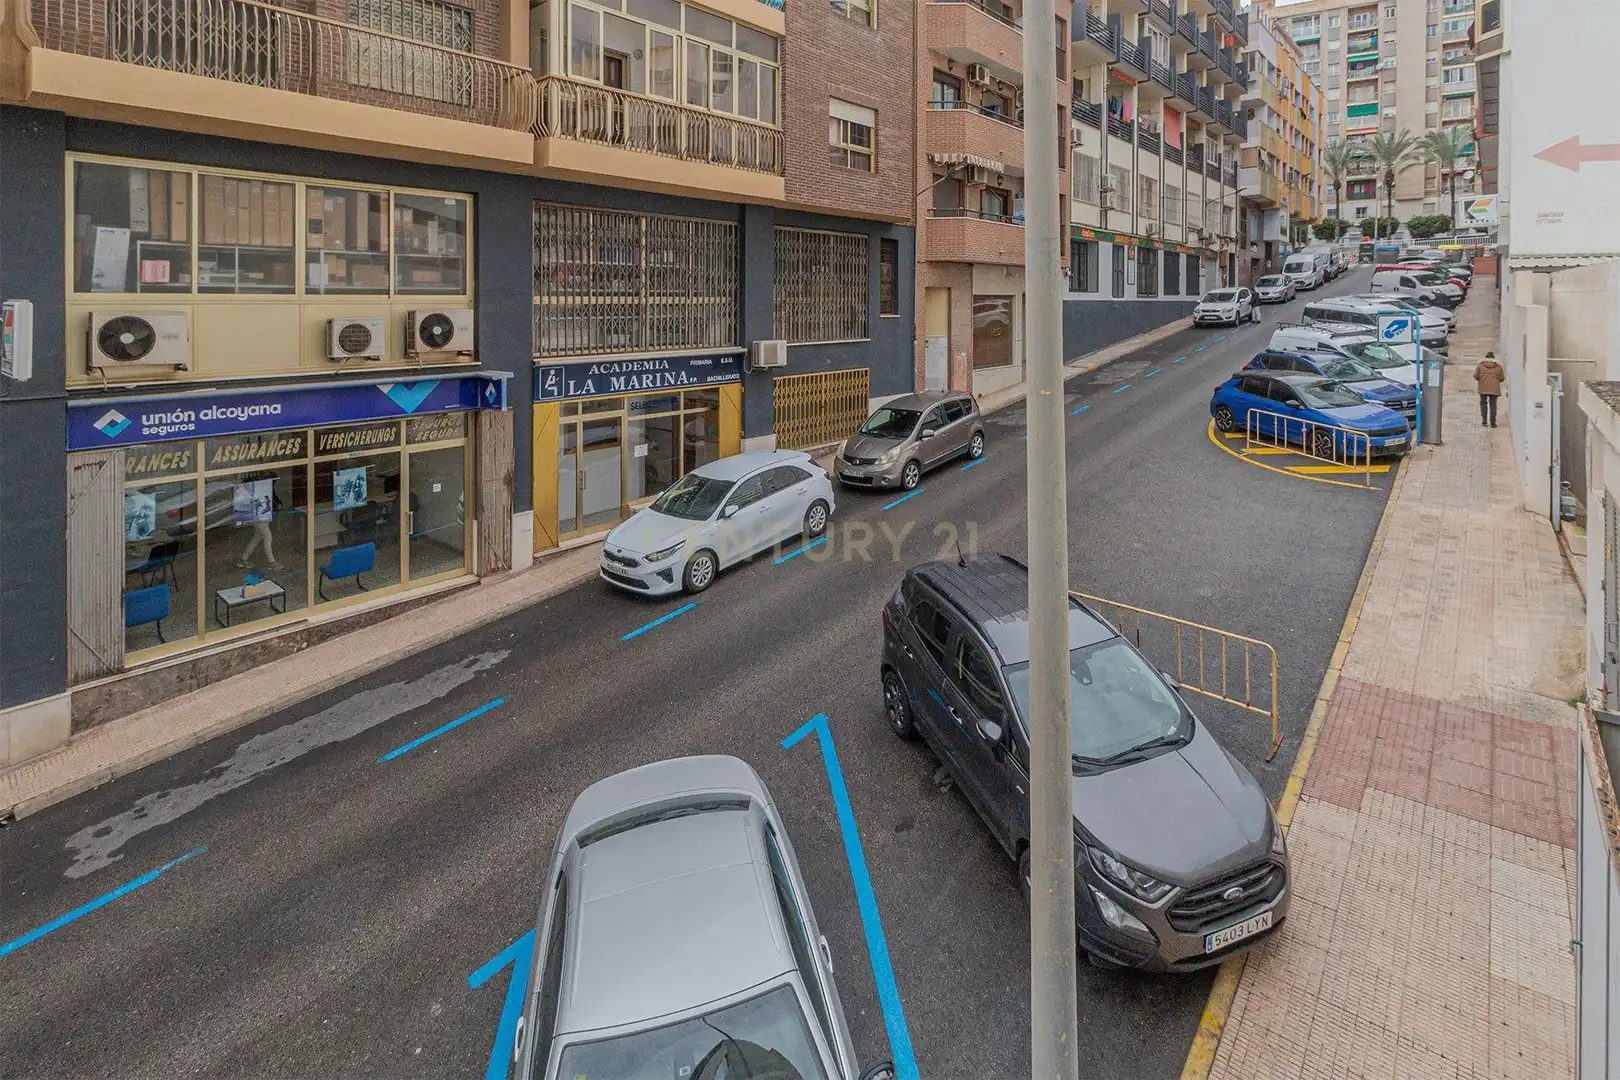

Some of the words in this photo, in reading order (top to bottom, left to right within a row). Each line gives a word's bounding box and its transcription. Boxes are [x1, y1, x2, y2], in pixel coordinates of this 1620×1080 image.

[588, 360, 670, 375] ACADEMIA
[707, 373, 741, 382] BACHILLERATO
[567, 379, 597, 396] LA
[610, 370, 689, 392] MARINA
[199, 403, 282, 421] alcoyana
[142, 422, 196, 436] seguros
[319, 426, 397, 450] VERSICHERUNGS
[211, 437, 302, 464] ASSURANCES
[1215, 925, 1244, 946] 5403
[1247, 915, 1269, 934] LYN
